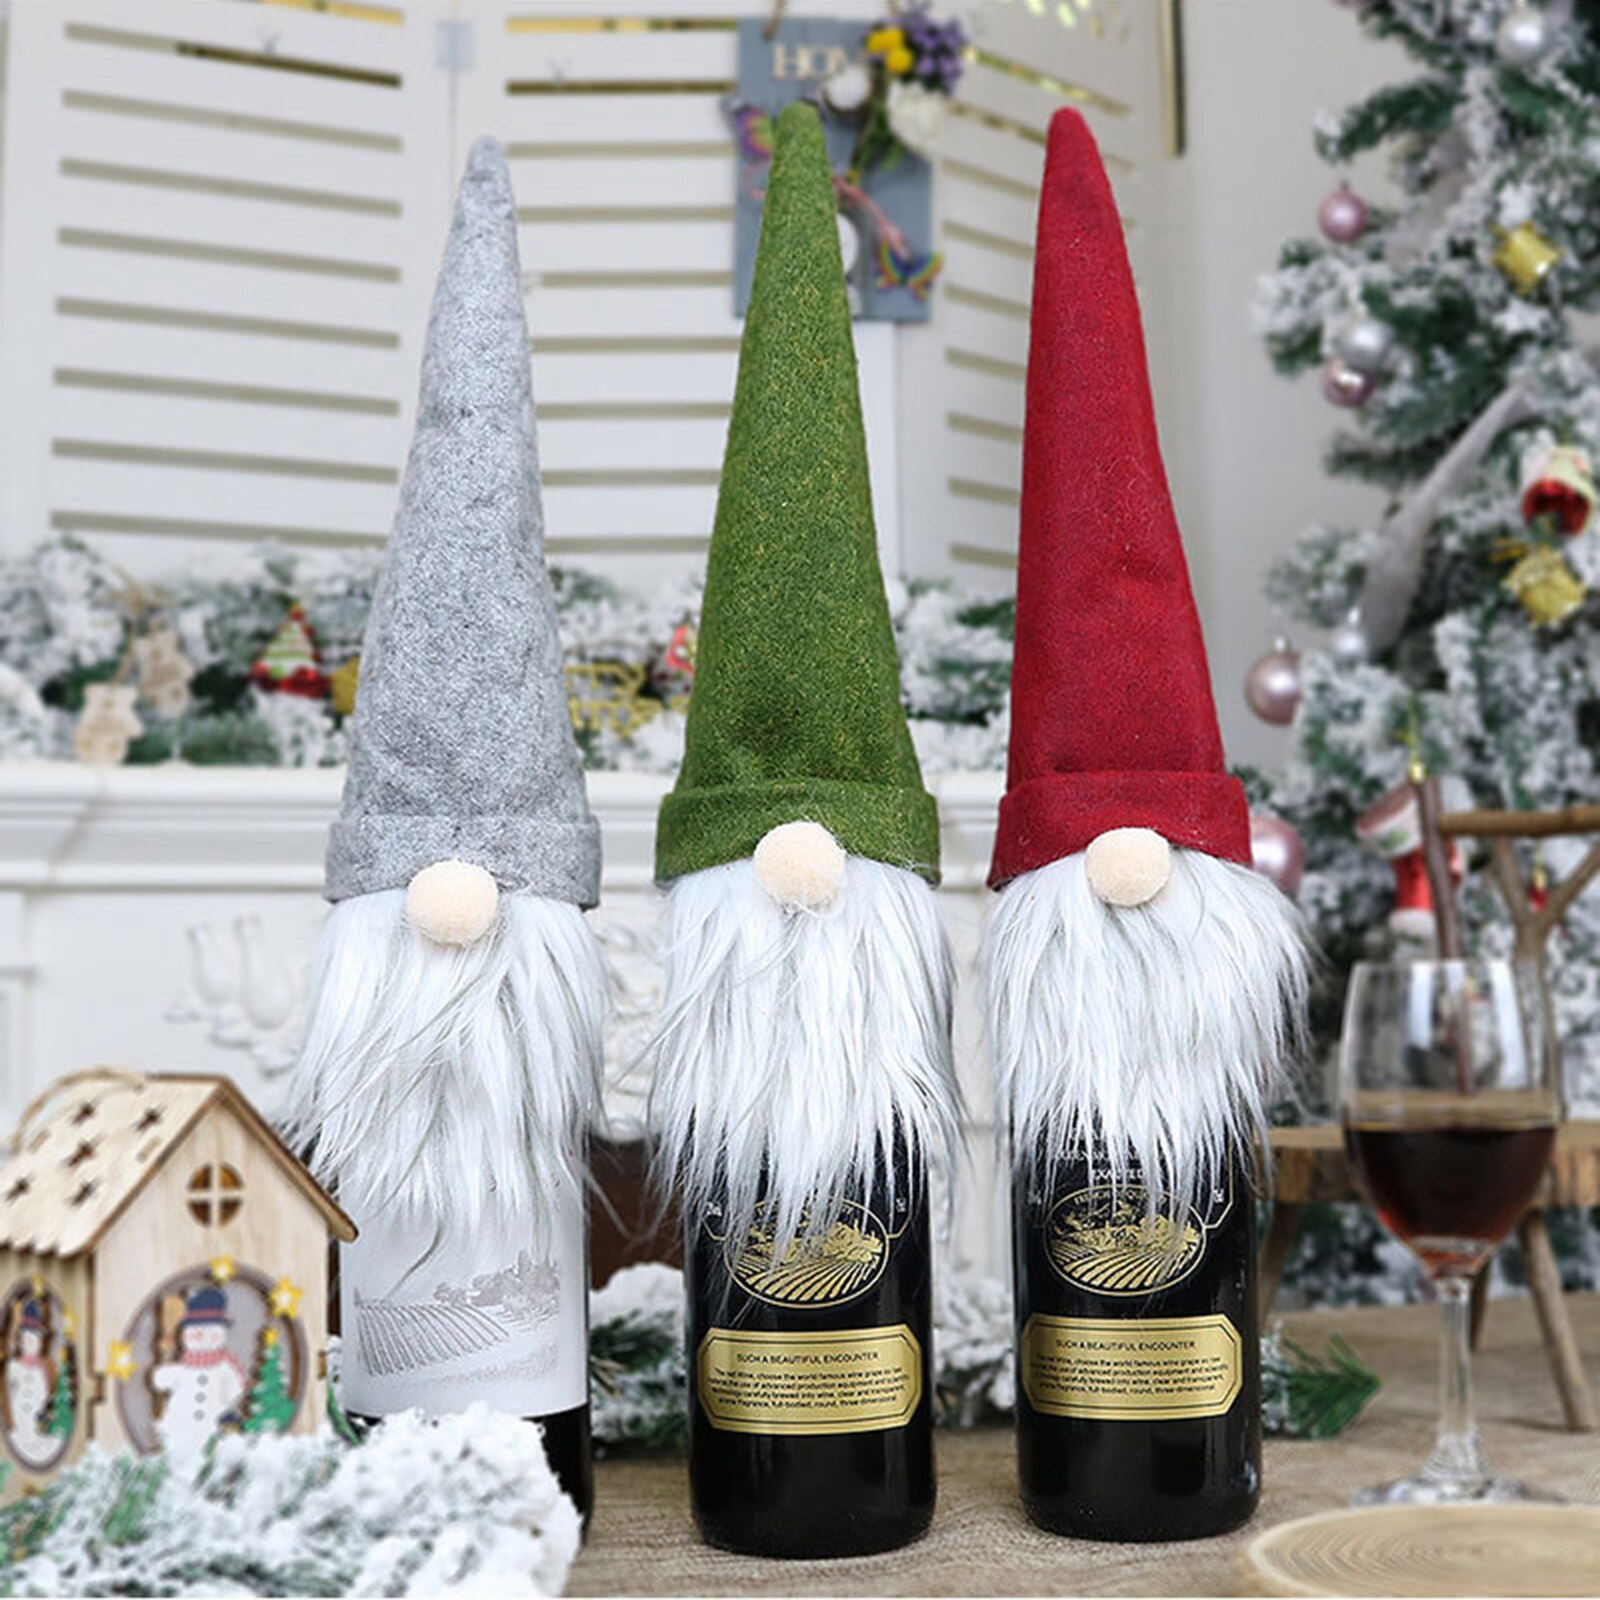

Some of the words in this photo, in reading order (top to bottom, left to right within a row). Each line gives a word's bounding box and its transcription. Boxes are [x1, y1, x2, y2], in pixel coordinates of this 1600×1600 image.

[1056, 1340, 1078, 1350] SUCH
[1087, 1341, 1137, 1352] BEAUTIFUL
[1138, 1340, 1196, 1352] ENCOUNTER
[736, 1353, 761, 1364] SUCH
[770, 1354, 822, 1365] BEAUTIFUL
[822, 1351, 879, 1364] ENCOUNTER
